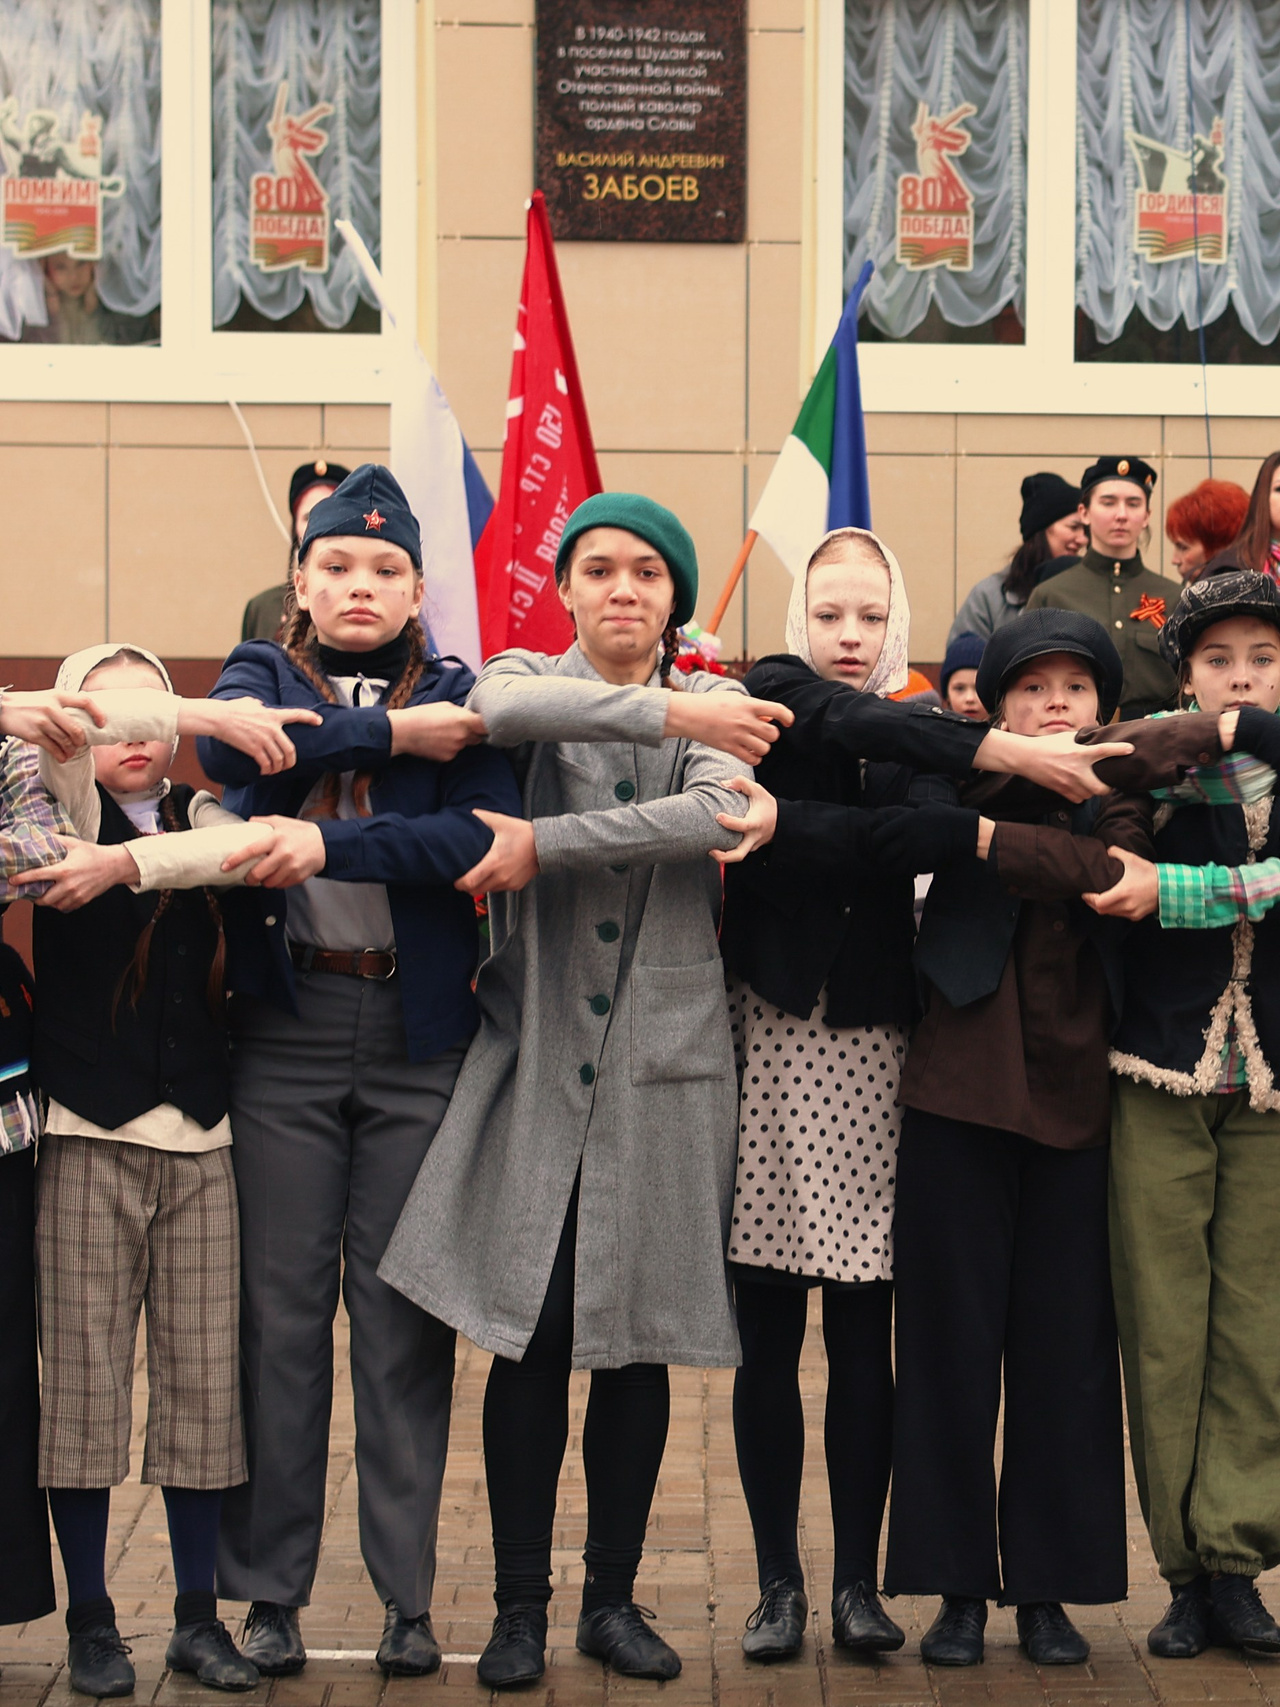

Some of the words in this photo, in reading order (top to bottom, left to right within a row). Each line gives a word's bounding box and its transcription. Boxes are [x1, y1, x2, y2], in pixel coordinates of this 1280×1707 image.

[575, 25, 586, 41] В
[589, 26, 661, 42] 1940-1942
[662, 30, 707, 43] годах
[557, 47, 566, 58] в
[568, 47, 633, 59] поселке
[635, 47, 691, 62] Шудаяг
[694, 50, 724, 61] жил
[574, 65, 642, 79] участник
[643, 63, 708, 78] Великой
[556, 79, 671, 96] Отечественной
[673, 81, 724, 97] войны,
[578, 98, 636, 113] полный
[637, 101, 703, 115] кавалер
[585, 117, 645, 132] ордена
[646, 116, 697, 131] Славы
[556, 151, 635, 167] ВАСИЛИЙ
[638, 153, 725, 169] АНДРЕЕВИЧ
[255, 176, 291, 211] 80
[582, 173, 700, 202] ЗАБОЕВ
[901, 176, 938, 211] 80
[1139, 194, 1223, 214] ГОРДИМСЯ!
[900, 216, 970, 238] ПОБЕДА!
